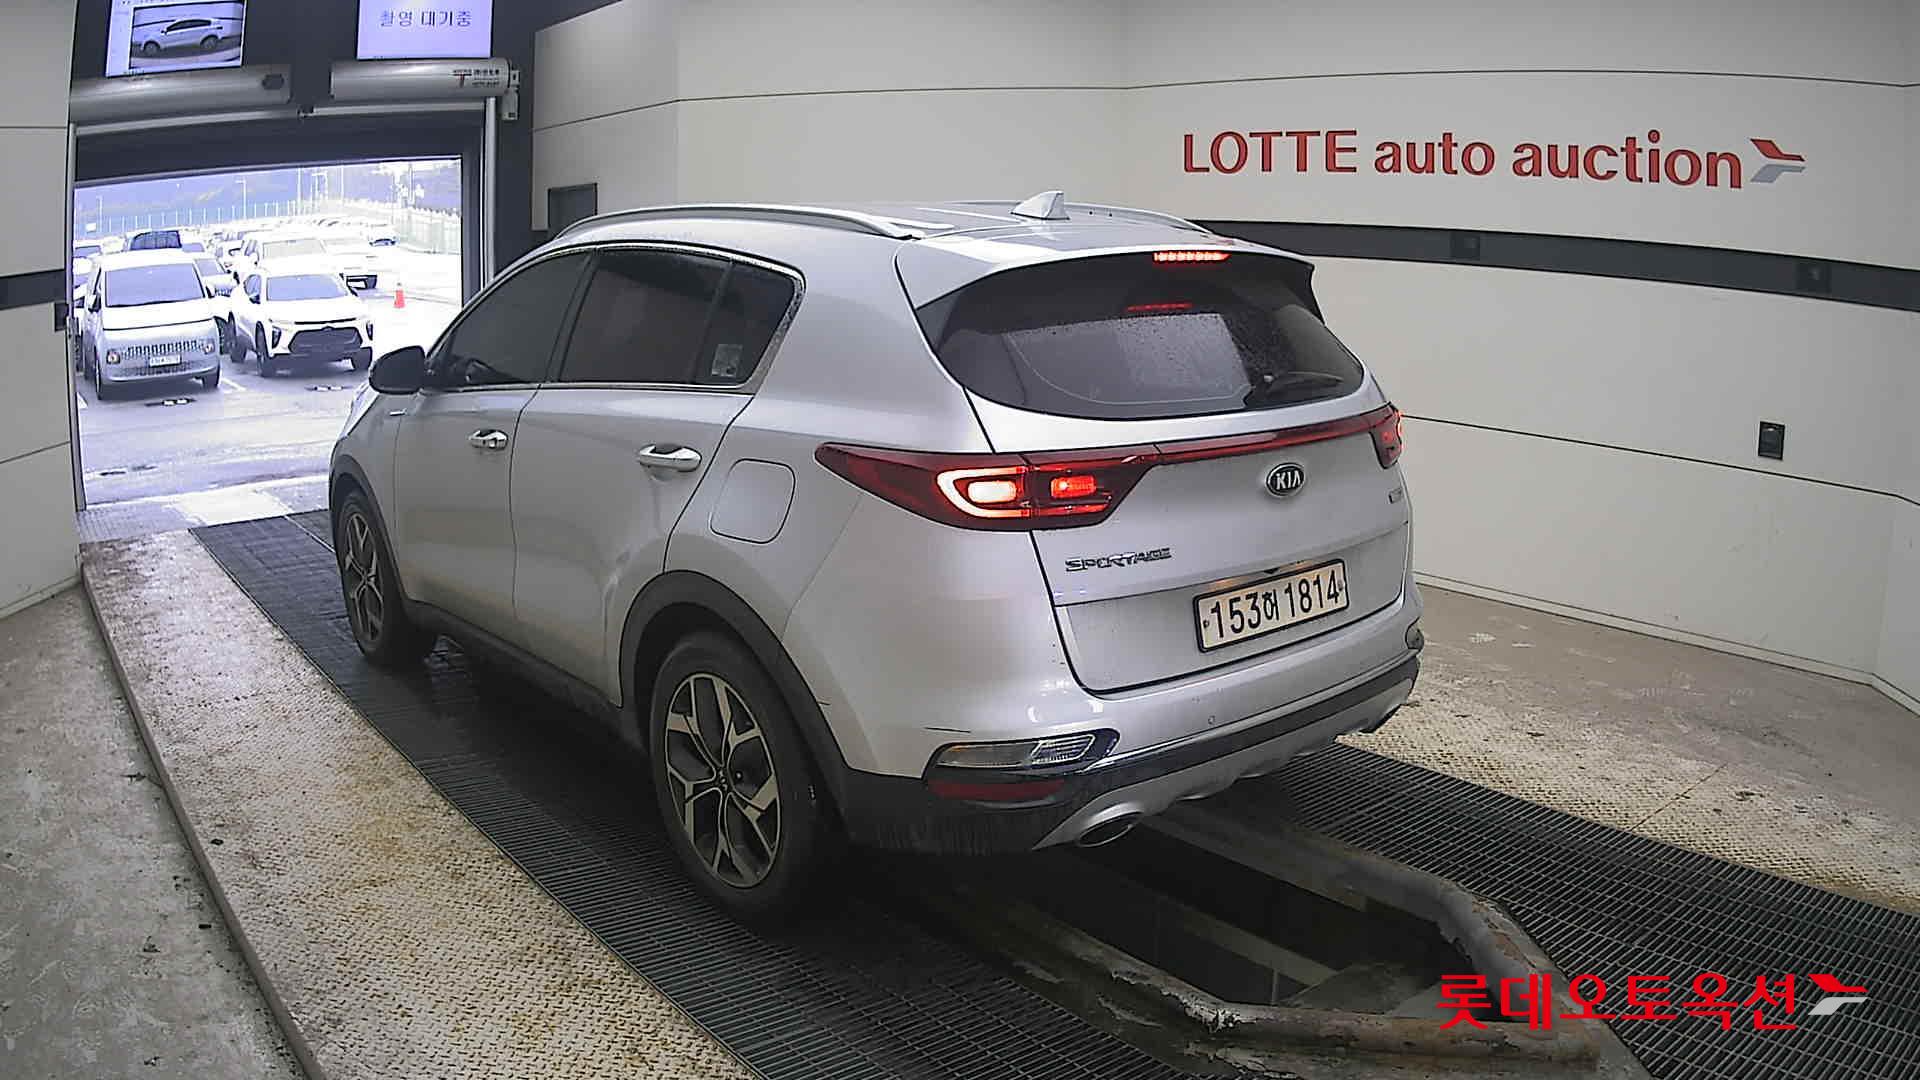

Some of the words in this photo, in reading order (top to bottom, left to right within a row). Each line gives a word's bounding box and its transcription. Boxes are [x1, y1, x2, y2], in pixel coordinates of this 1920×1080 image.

[421, 10, 472, 27] 대기중
[1184, 129, 1357, 173] LOTTE
[1374, 131, 1496, 176] auto
[1512, 129, 1743, 189] auction
[1275, 470, 1302, 490] KIA
[1064, 547, 1172, 573] SPORTAGE
